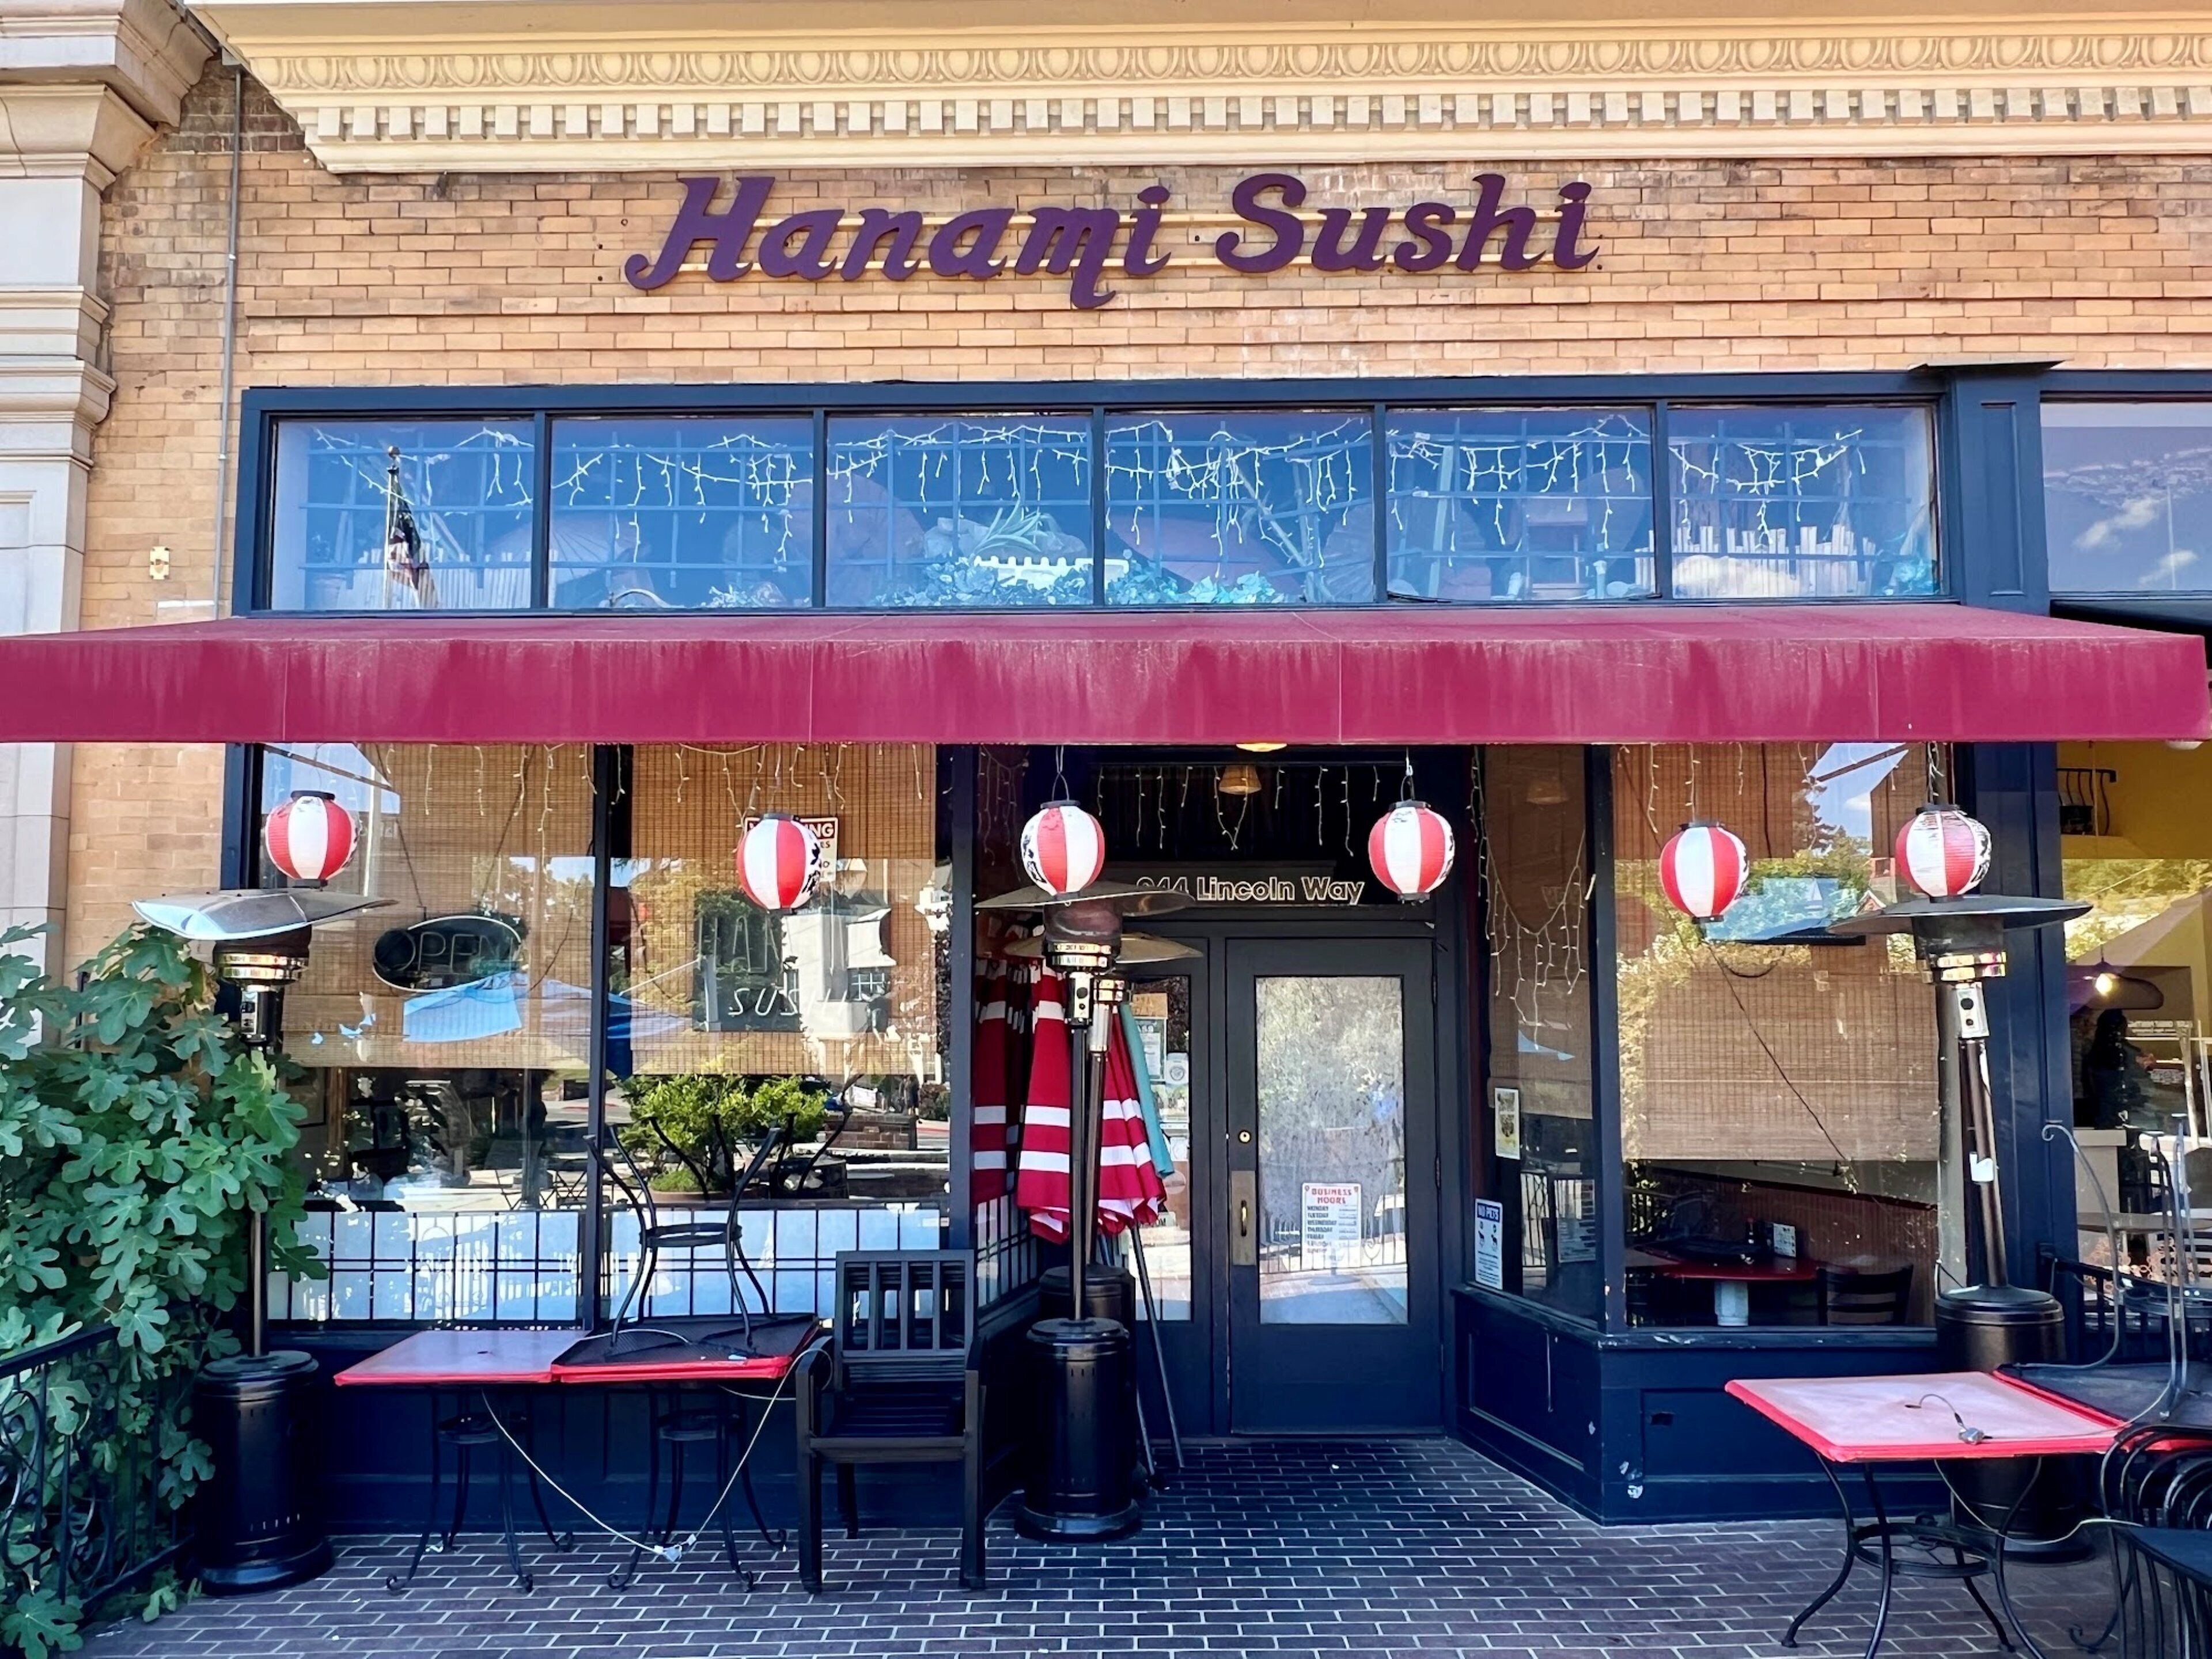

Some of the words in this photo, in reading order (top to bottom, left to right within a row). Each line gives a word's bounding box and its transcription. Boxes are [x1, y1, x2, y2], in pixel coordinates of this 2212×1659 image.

[624, 176, 1172, 309] Hanami
[1215, 173, 1600, 273] Sushi
[1197, 877, 1295, 902] Lincoln
[1301, 877, 1365, 906] Way
[374, 929, 513, 975] OPEN
